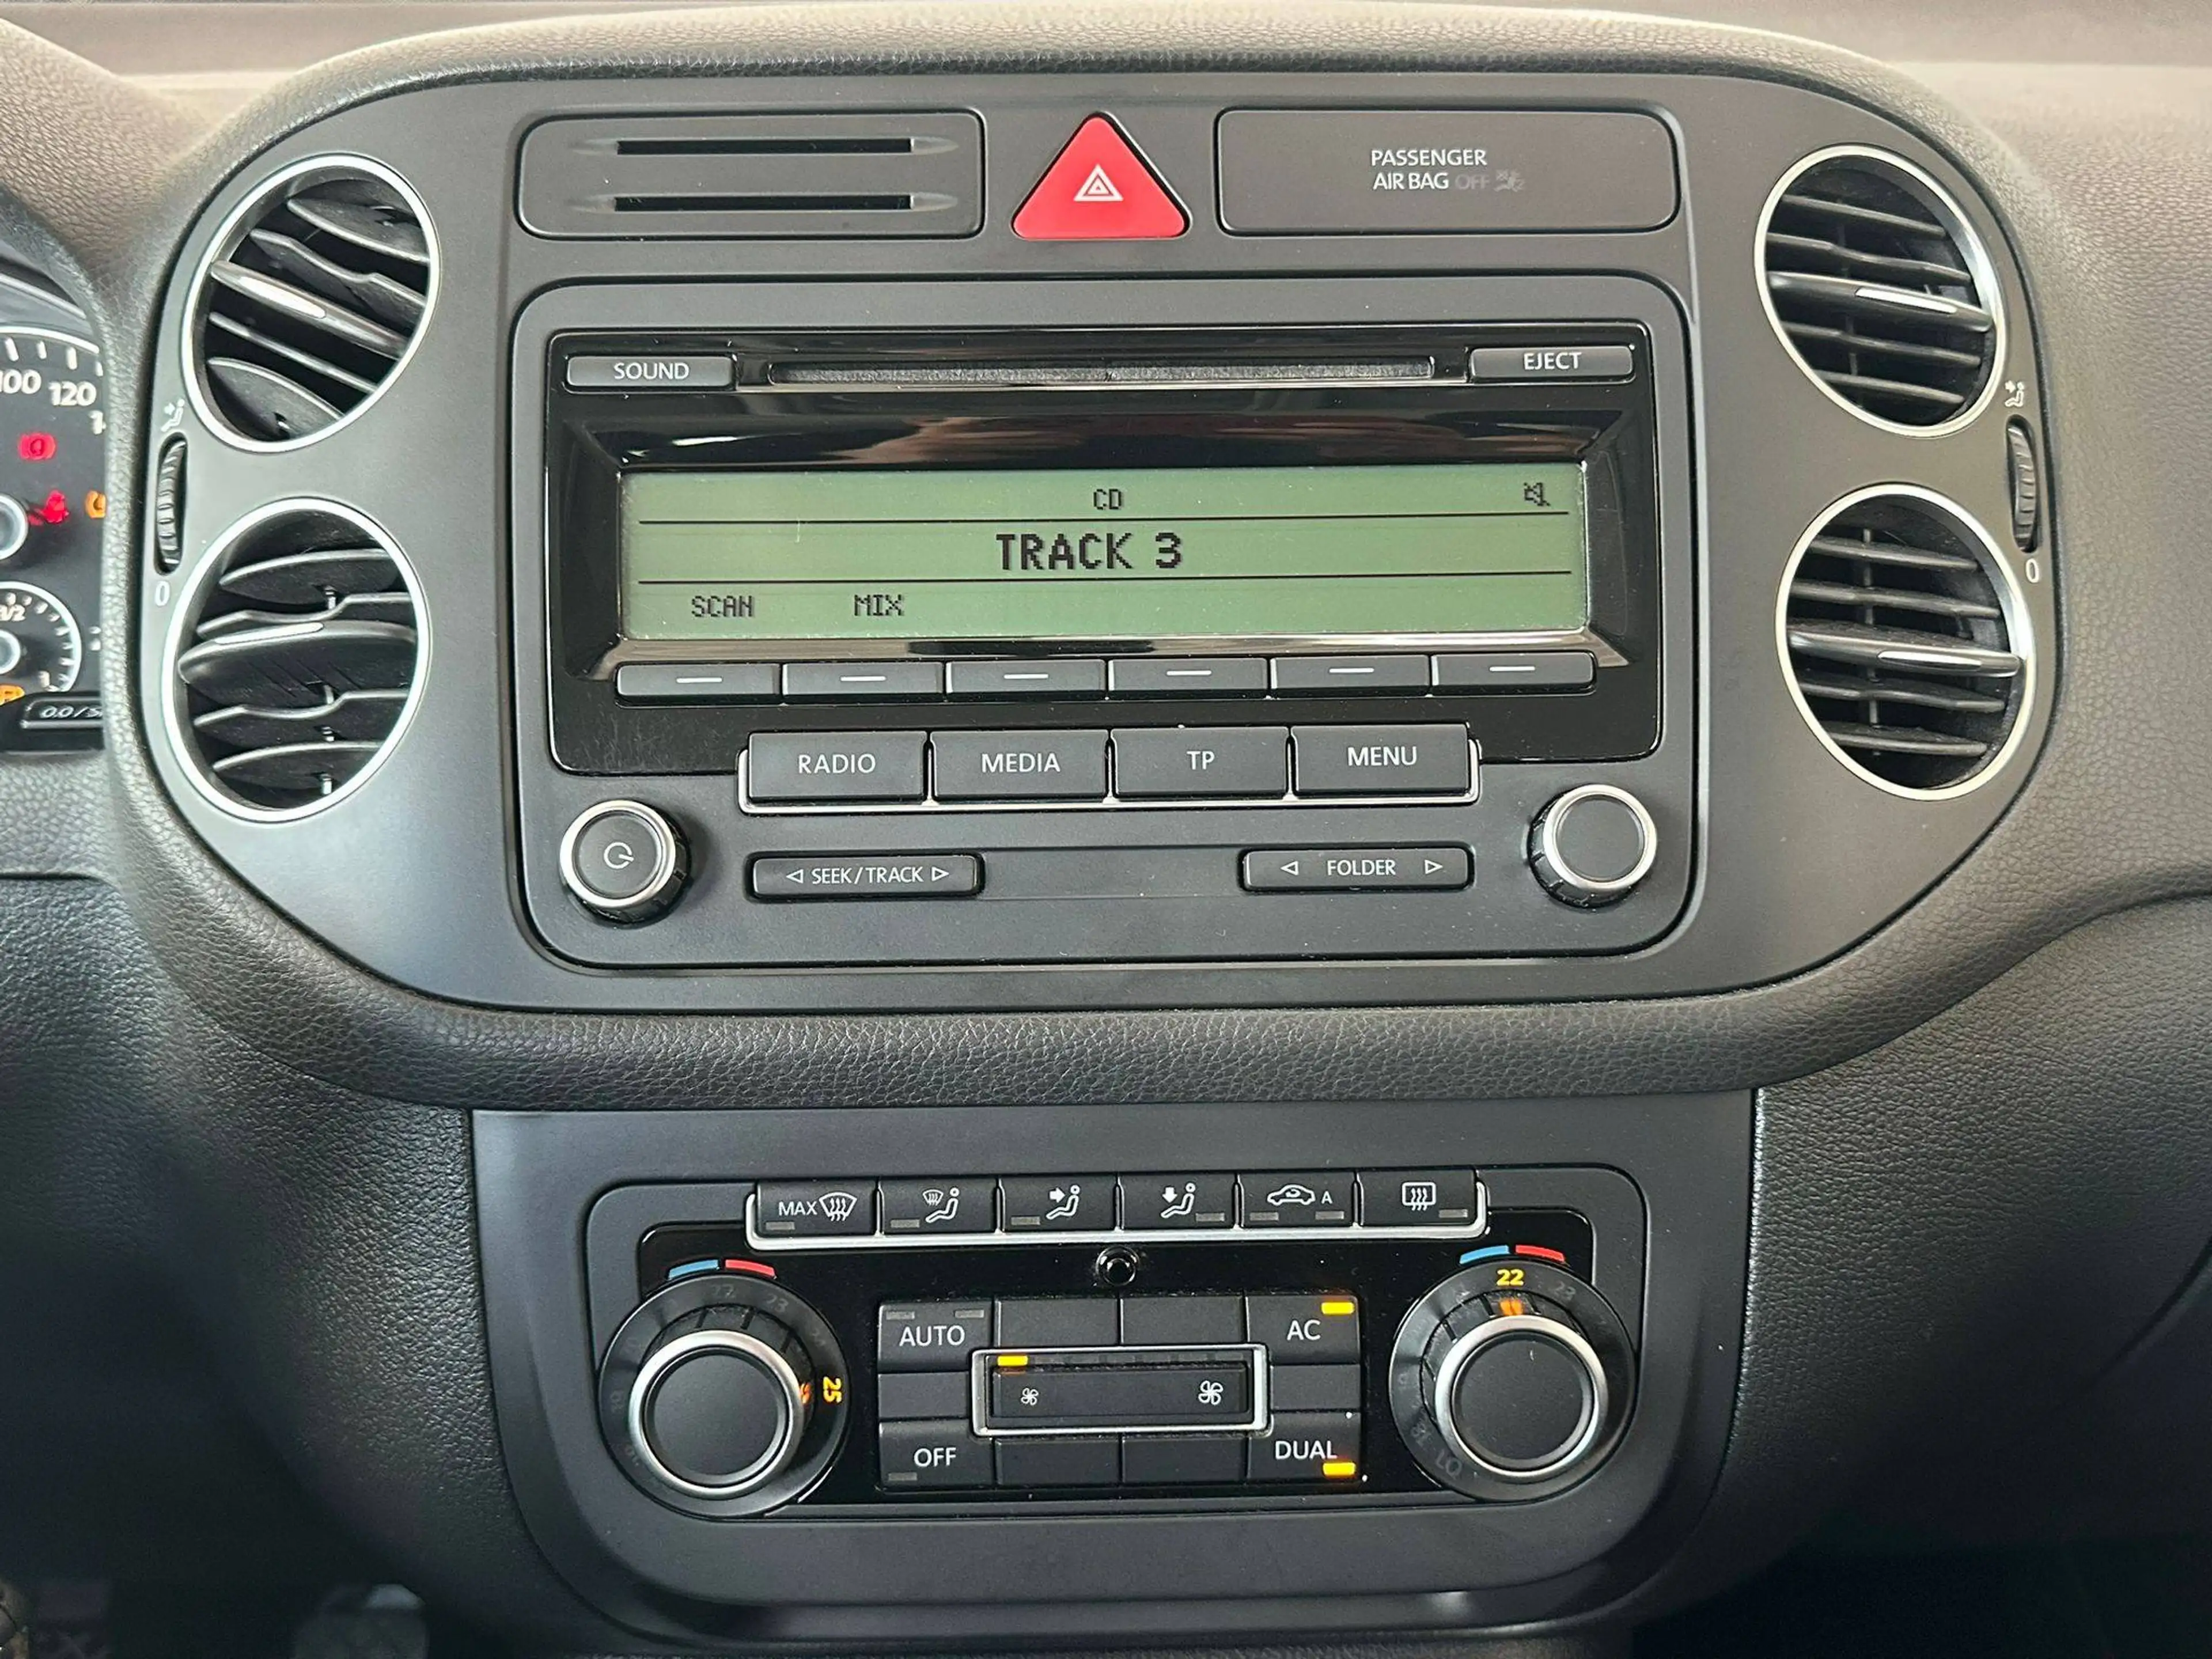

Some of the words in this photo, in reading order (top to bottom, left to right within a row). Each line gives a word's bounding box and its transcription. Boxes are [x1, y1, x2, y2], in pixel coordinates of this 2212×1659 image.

[1371, 148, 1488, 166] PASSENGER
[1455, 173, 1490, 191] OFF
[613, 362, 690, 381] SOUND
[1523, 351, 1583, 370] EJECT
[48, 381, 97, 407] 120
[1092, 488, 1124, 511] CD
[995, 532, 1135, 571] TRACK
[1153, 532, 1183, 570] 3
[2025, 558, 2040, 584] 0
[154, 580, 171, 607] 0
[690, 594, 755, 618] SCAN
[853, 593, 904, 617] MIX
[798, 753, 877, 775] RADIO
[981, 752, 1060, 774] MEDIA
[1187, 751, 1215, 771] TP
[1347, 746, 1418, 767] MENU
[1327, 859, 1397, 877] FOLDER
[778, 1200, 818, 1217] MAX
[1321, 1191, 1334, 1205] A
[1496, 1268, 1526, 1286] 22
[899, 1325, 965, 1347] AUTO
[1286, 1319, 1321, 1341] AC
[822, 1376, 843, 1404] 25
[913, 1446, 957, 1468] OFF
[1274, 1440, 1338, 1460] DUAL
